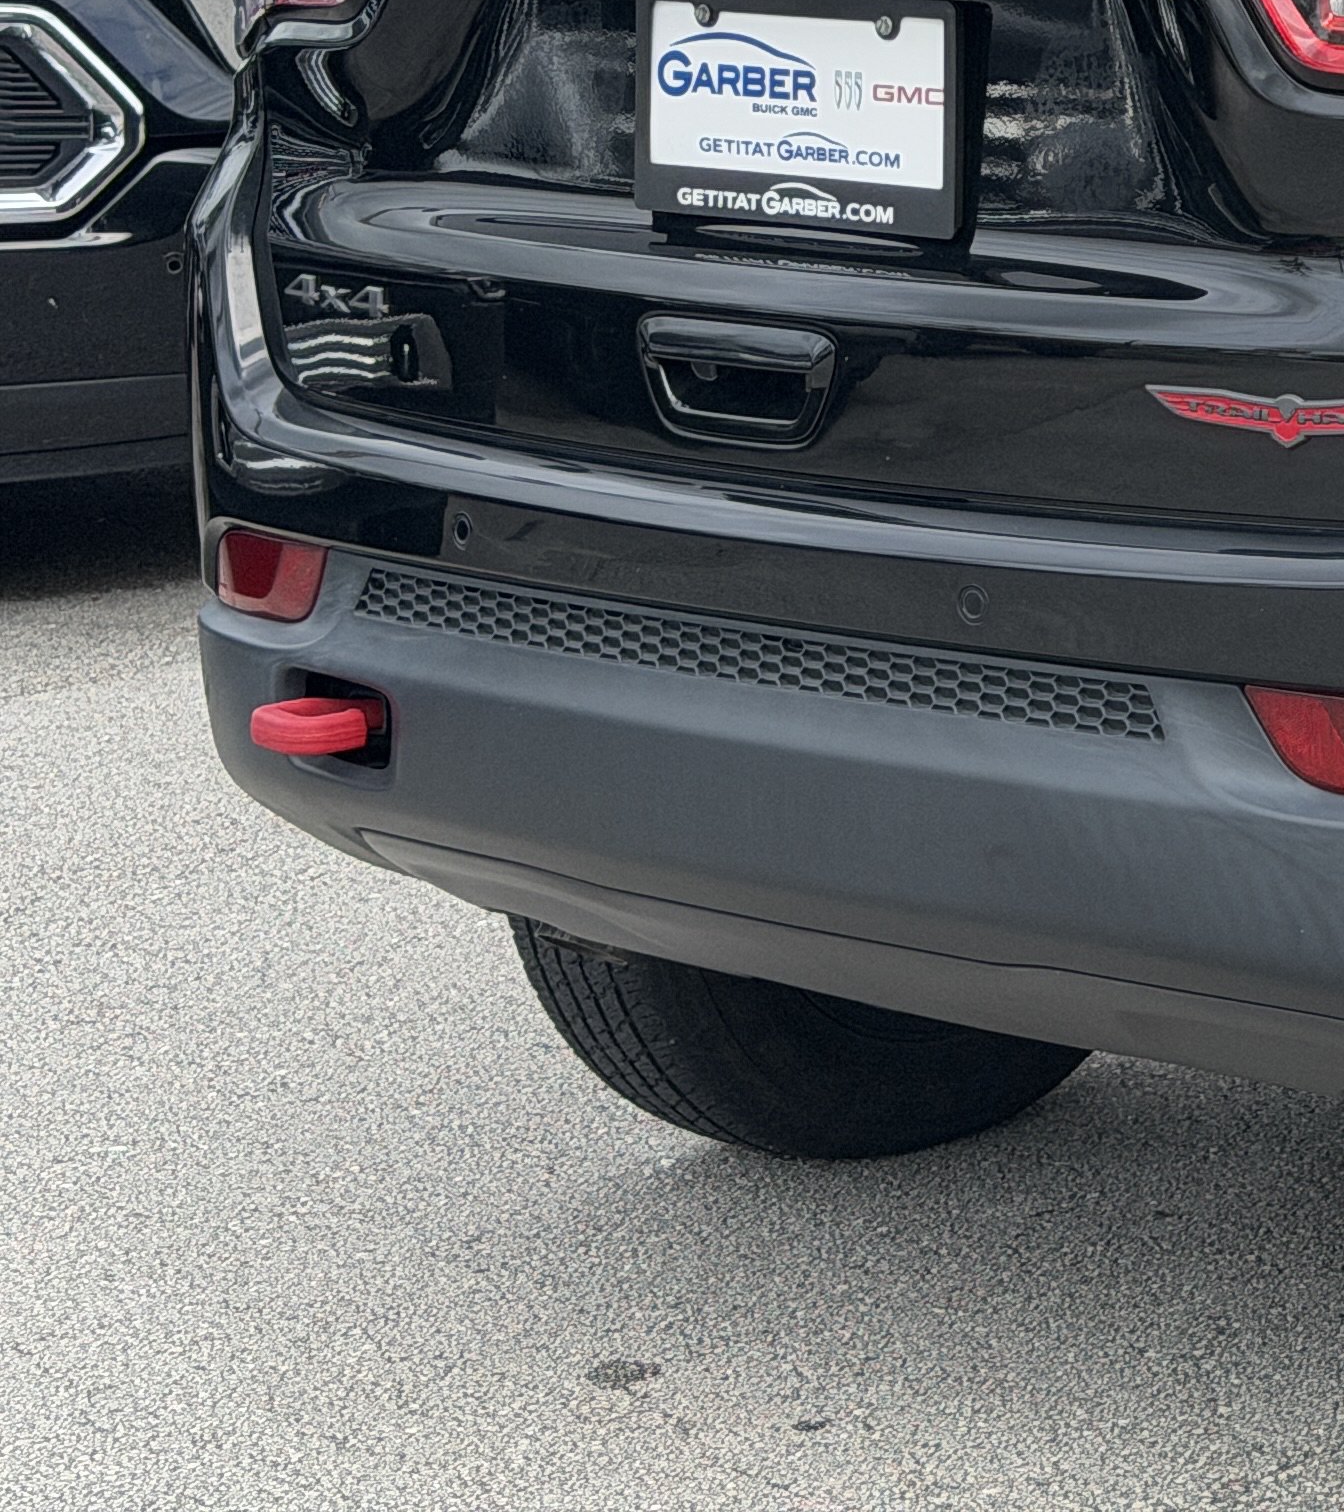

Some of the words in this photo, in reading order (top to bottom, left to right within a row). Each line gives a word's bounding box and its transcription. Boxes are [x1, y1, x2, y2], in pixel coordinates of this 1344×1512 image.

[658, 50, 817, 102] GARBER
[752, 103, 788, 115] BUICK
[792, 106, 818, 117] GMC
[873, 83, 944, 105] GMC
[284, 274, 390, 318] 4x4
